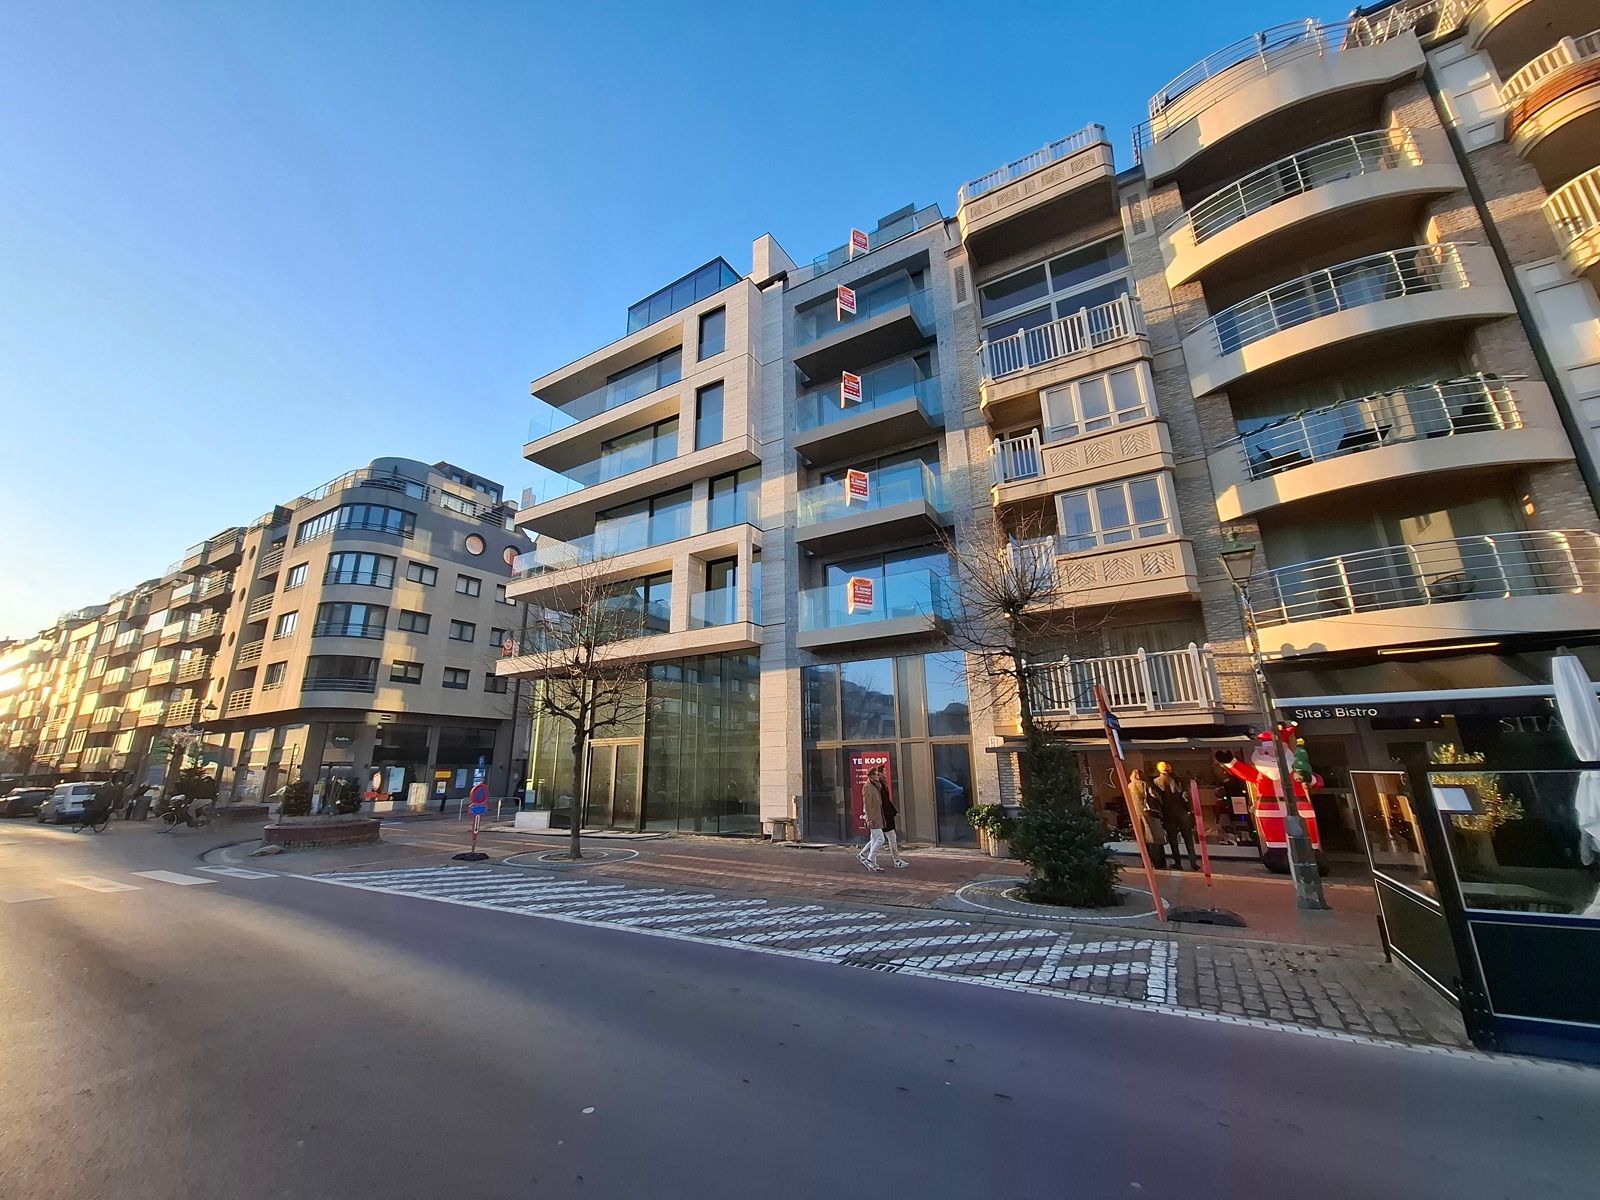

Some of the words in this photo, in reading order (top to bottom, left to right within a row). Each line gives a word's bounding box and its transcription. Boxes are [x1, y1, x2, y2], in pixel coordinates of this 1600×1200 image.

[1295, 708, 1331, 719] Sita's
[1335, 707, 1378, 717] Bistro
[864, 757, 888, 765] KOOP
